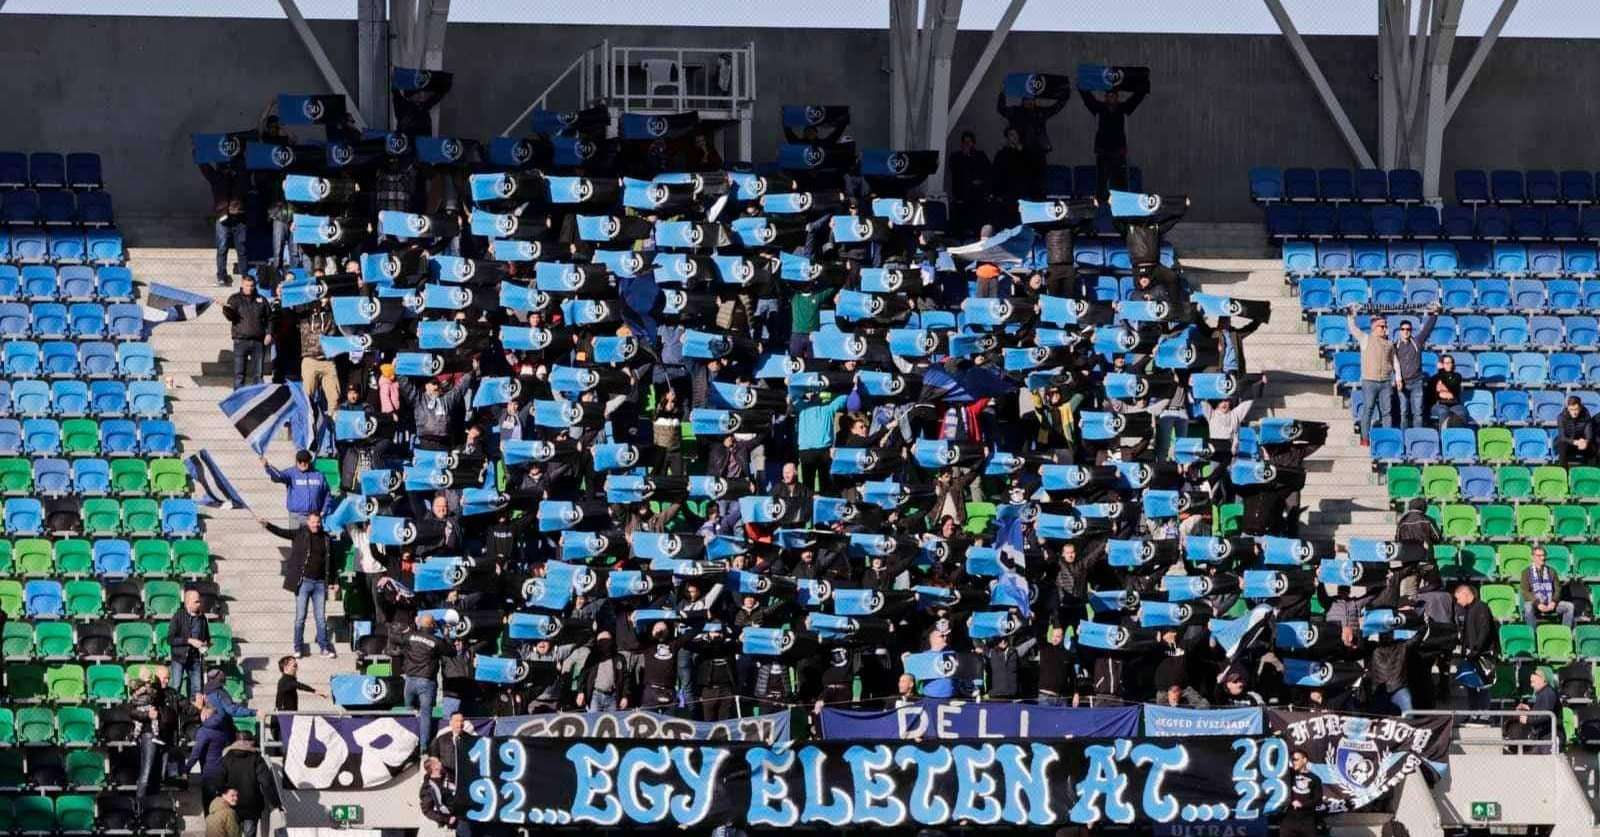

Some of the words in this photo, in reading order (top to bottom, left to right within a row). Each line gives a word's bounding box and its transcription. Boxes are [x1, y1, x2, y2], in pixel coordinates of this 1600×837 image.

[468, 737, 527, 781] 19
[1232, 738, 1289, 781] 20
[566, 743, 731, 826] EGY
